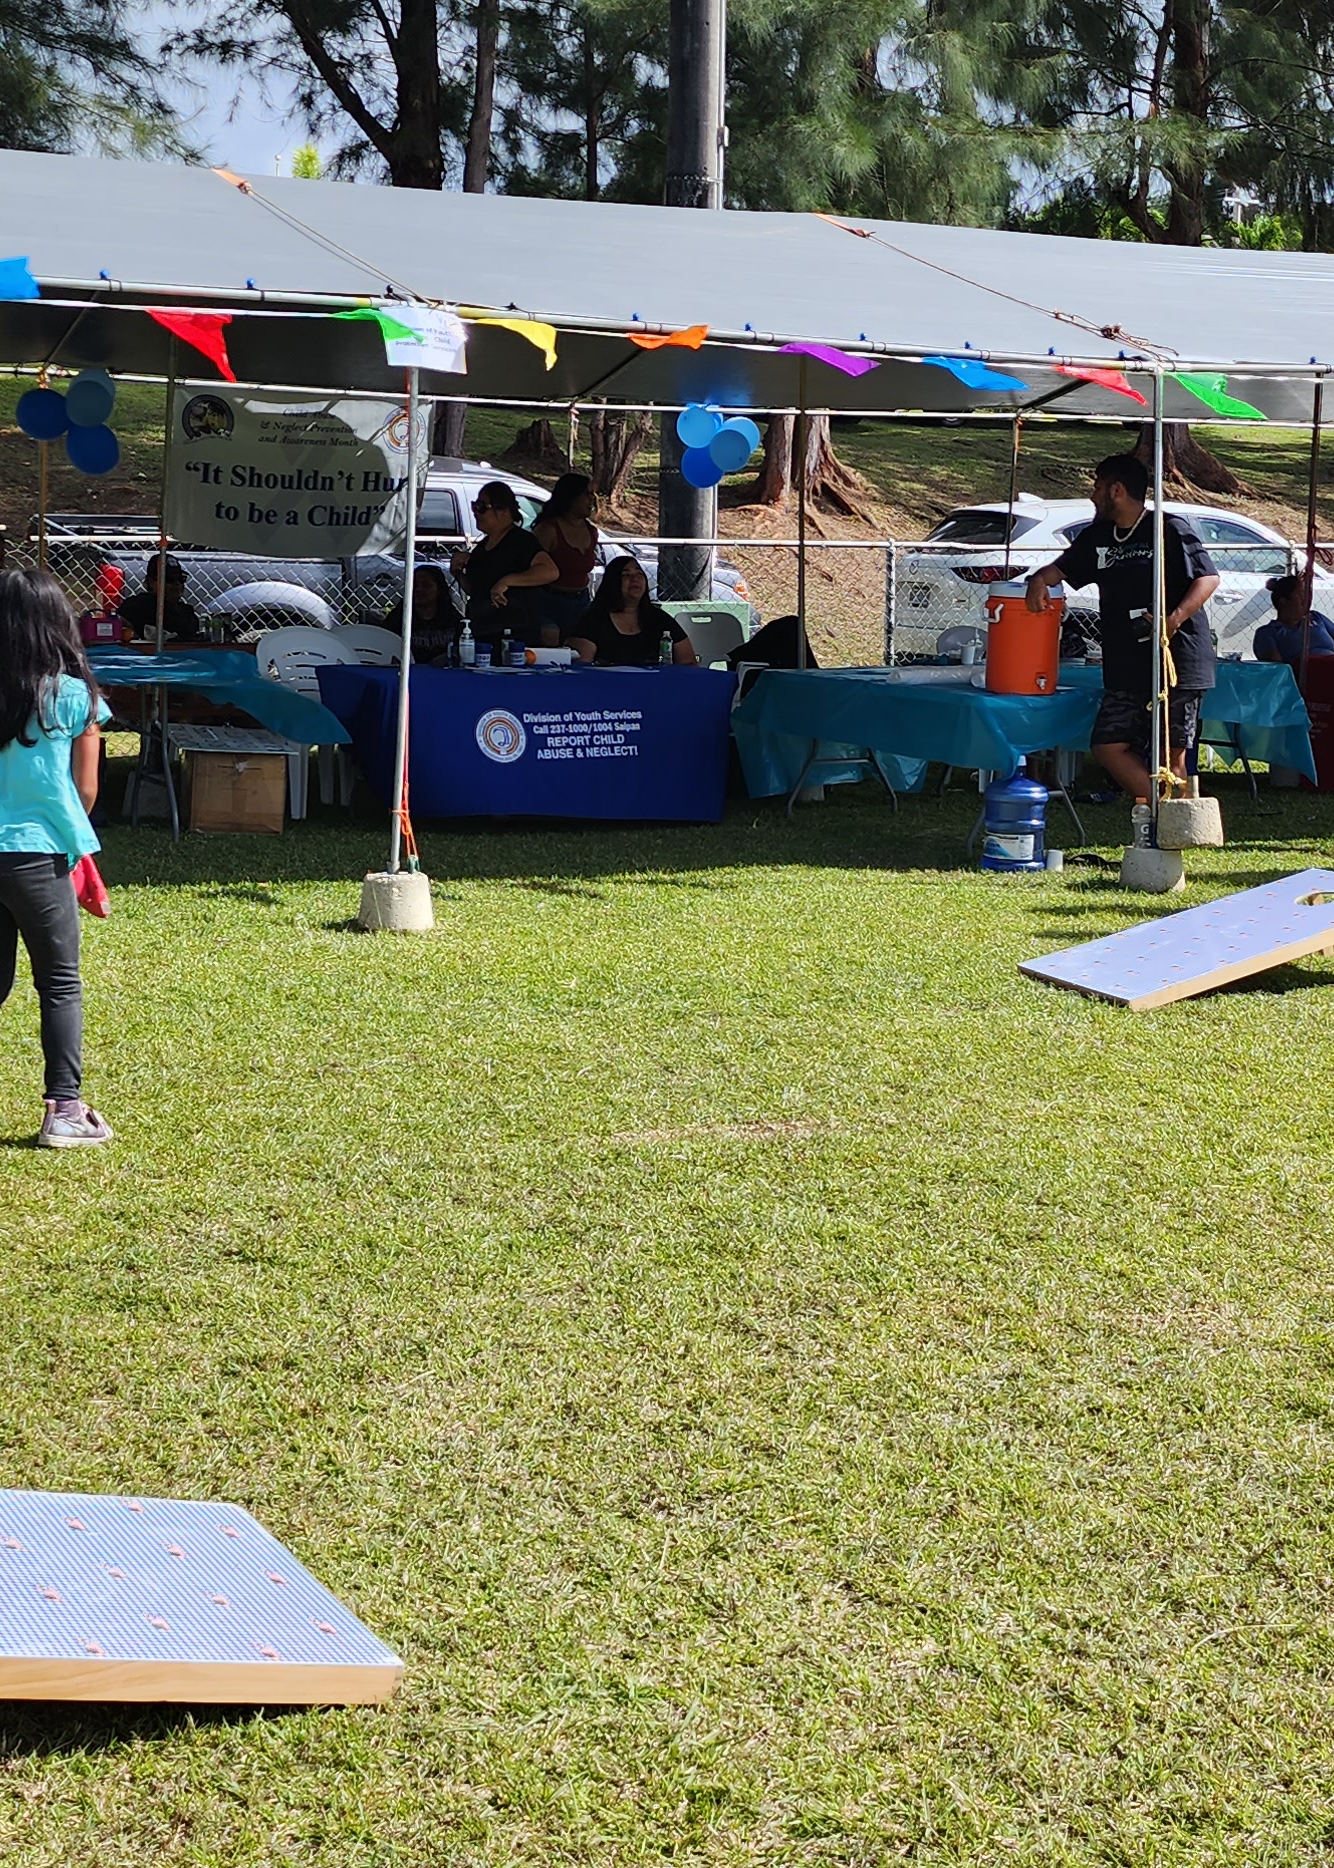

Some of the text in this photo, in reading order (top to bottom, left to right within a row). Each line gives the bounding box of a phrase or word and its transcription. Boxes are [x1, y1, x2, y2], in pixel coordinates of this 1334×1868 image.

[279, 436, 326, 446] Awareness
[329, 438, 359, 446] Month
[185, 461, 223, 485] “It
[361, 471, 409, 492] Hur
[215, 500, 239, 522] to
[248, 502, 276, 524] be
[285, 508, 299, 525] a
[523, 710, 642, 722] Division of Youth Services
[533, 725, 548, 734] Call
[614, 722, 640, 732] Saipan
[547, 734, 624, 747] REPORT CHILD
[537, 746, 638, 759] ABUSE & NEGLECT!
